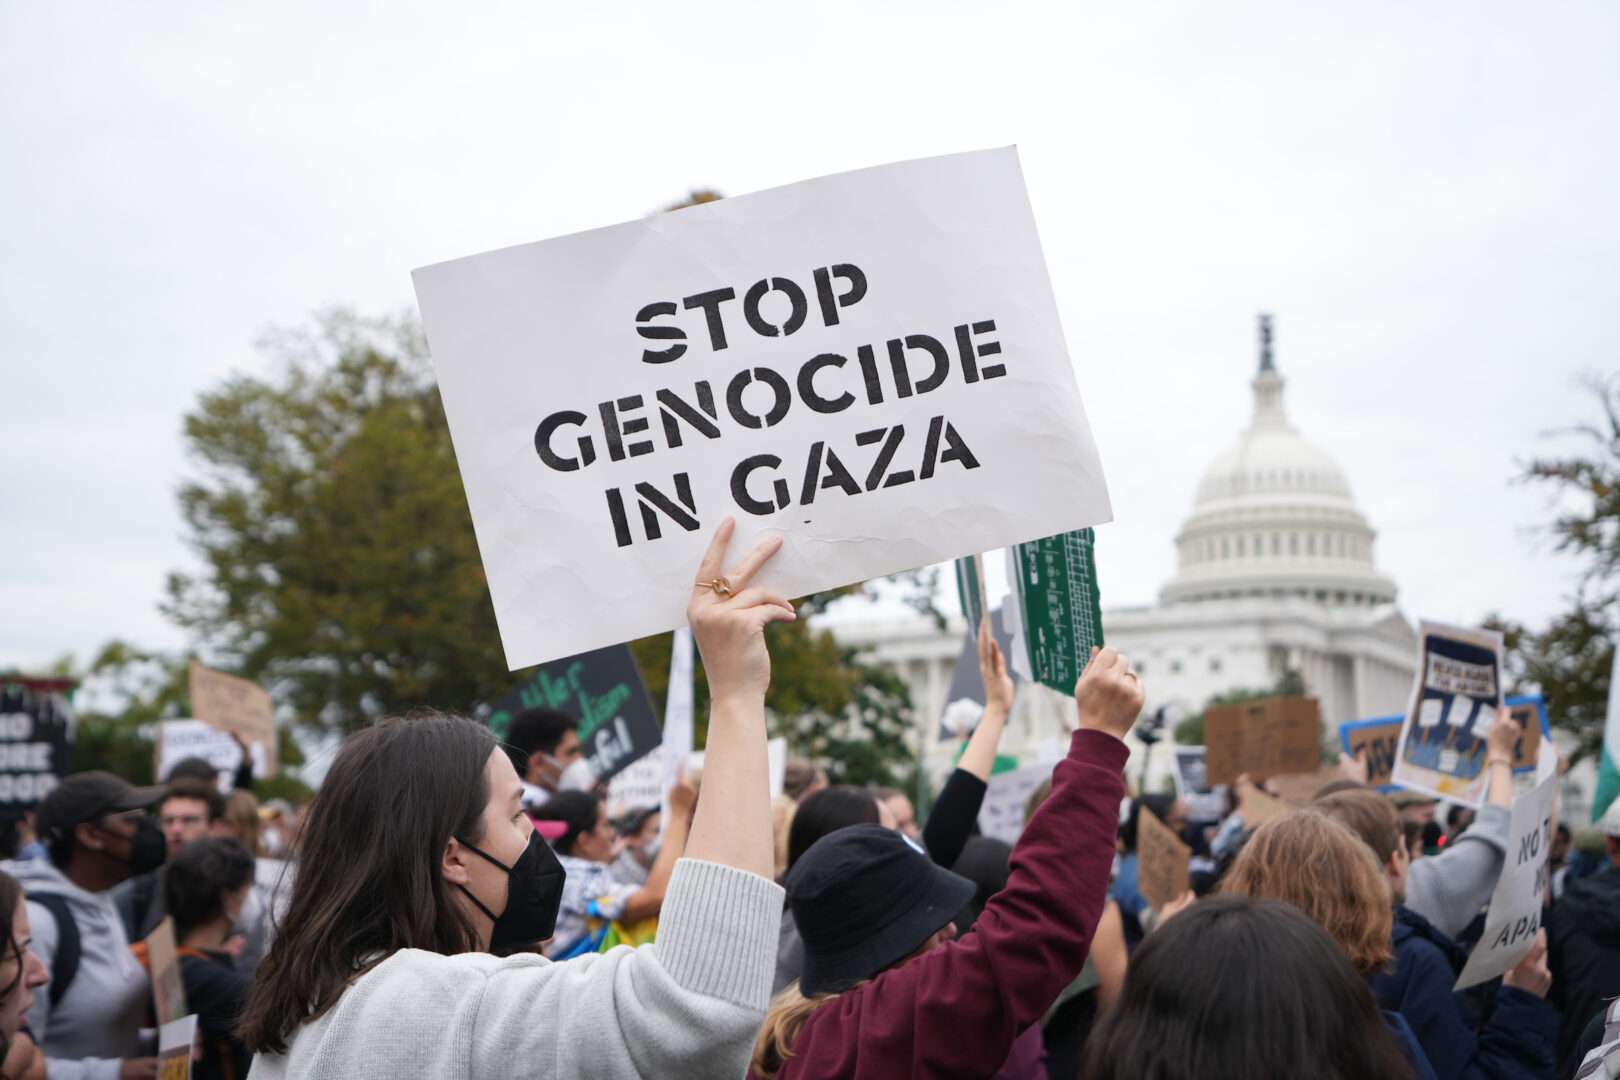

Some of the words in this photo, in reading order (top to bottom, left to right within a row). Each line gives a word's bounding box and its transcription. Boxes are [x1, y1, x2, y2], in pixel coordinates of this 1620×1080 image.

[635, 263, 868, 364] STOP
[534, 319, 1007, 473] GENOCIDE
[604, 472, 701, 548] IN
[730, 415, 981, 517] GAZA
[1518, 828, 1540, 865] NO
